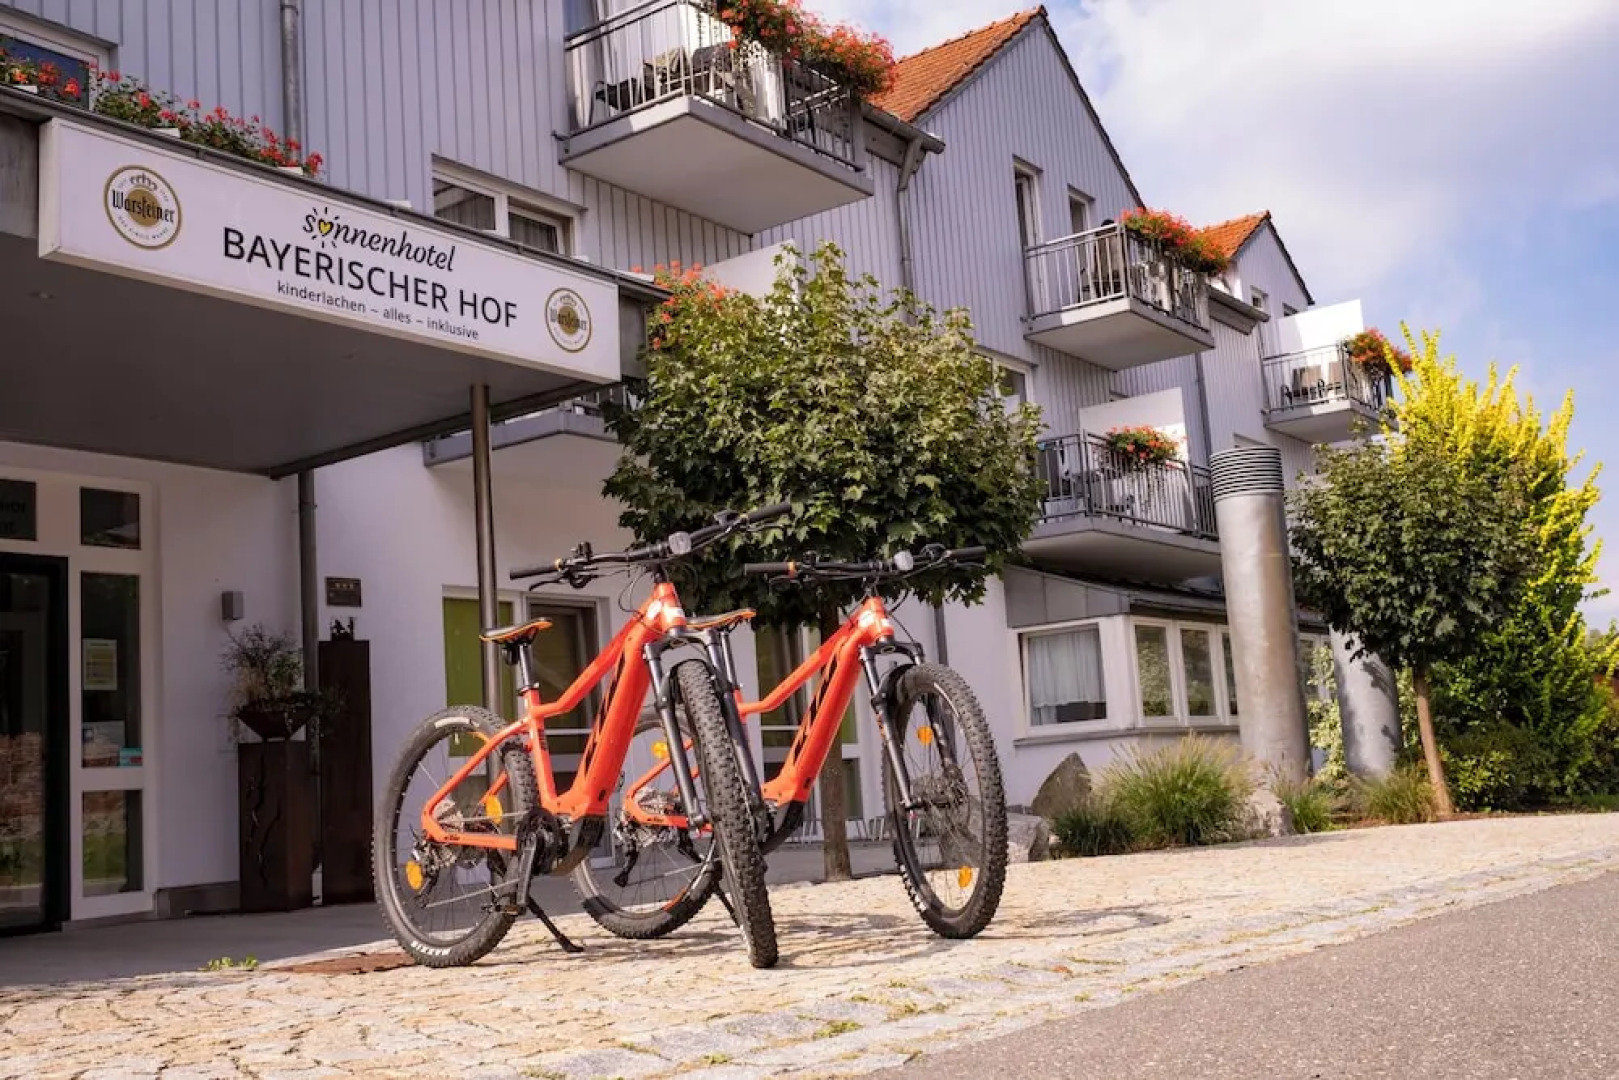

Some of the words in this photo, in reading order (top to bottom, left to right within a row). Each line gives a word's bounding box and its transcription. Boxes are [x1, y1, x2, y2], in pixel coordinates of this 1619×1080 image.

[112, 188, 175, 223] Warsteiner
[223, 226, 449, 313] BAYERISCHER
[459, 289, 518, 328] HOF
[277, 280, 366, 314] kinderlachen
[383, 307, 412, 325] alles
[427, 316, 479, 340] inklusive
